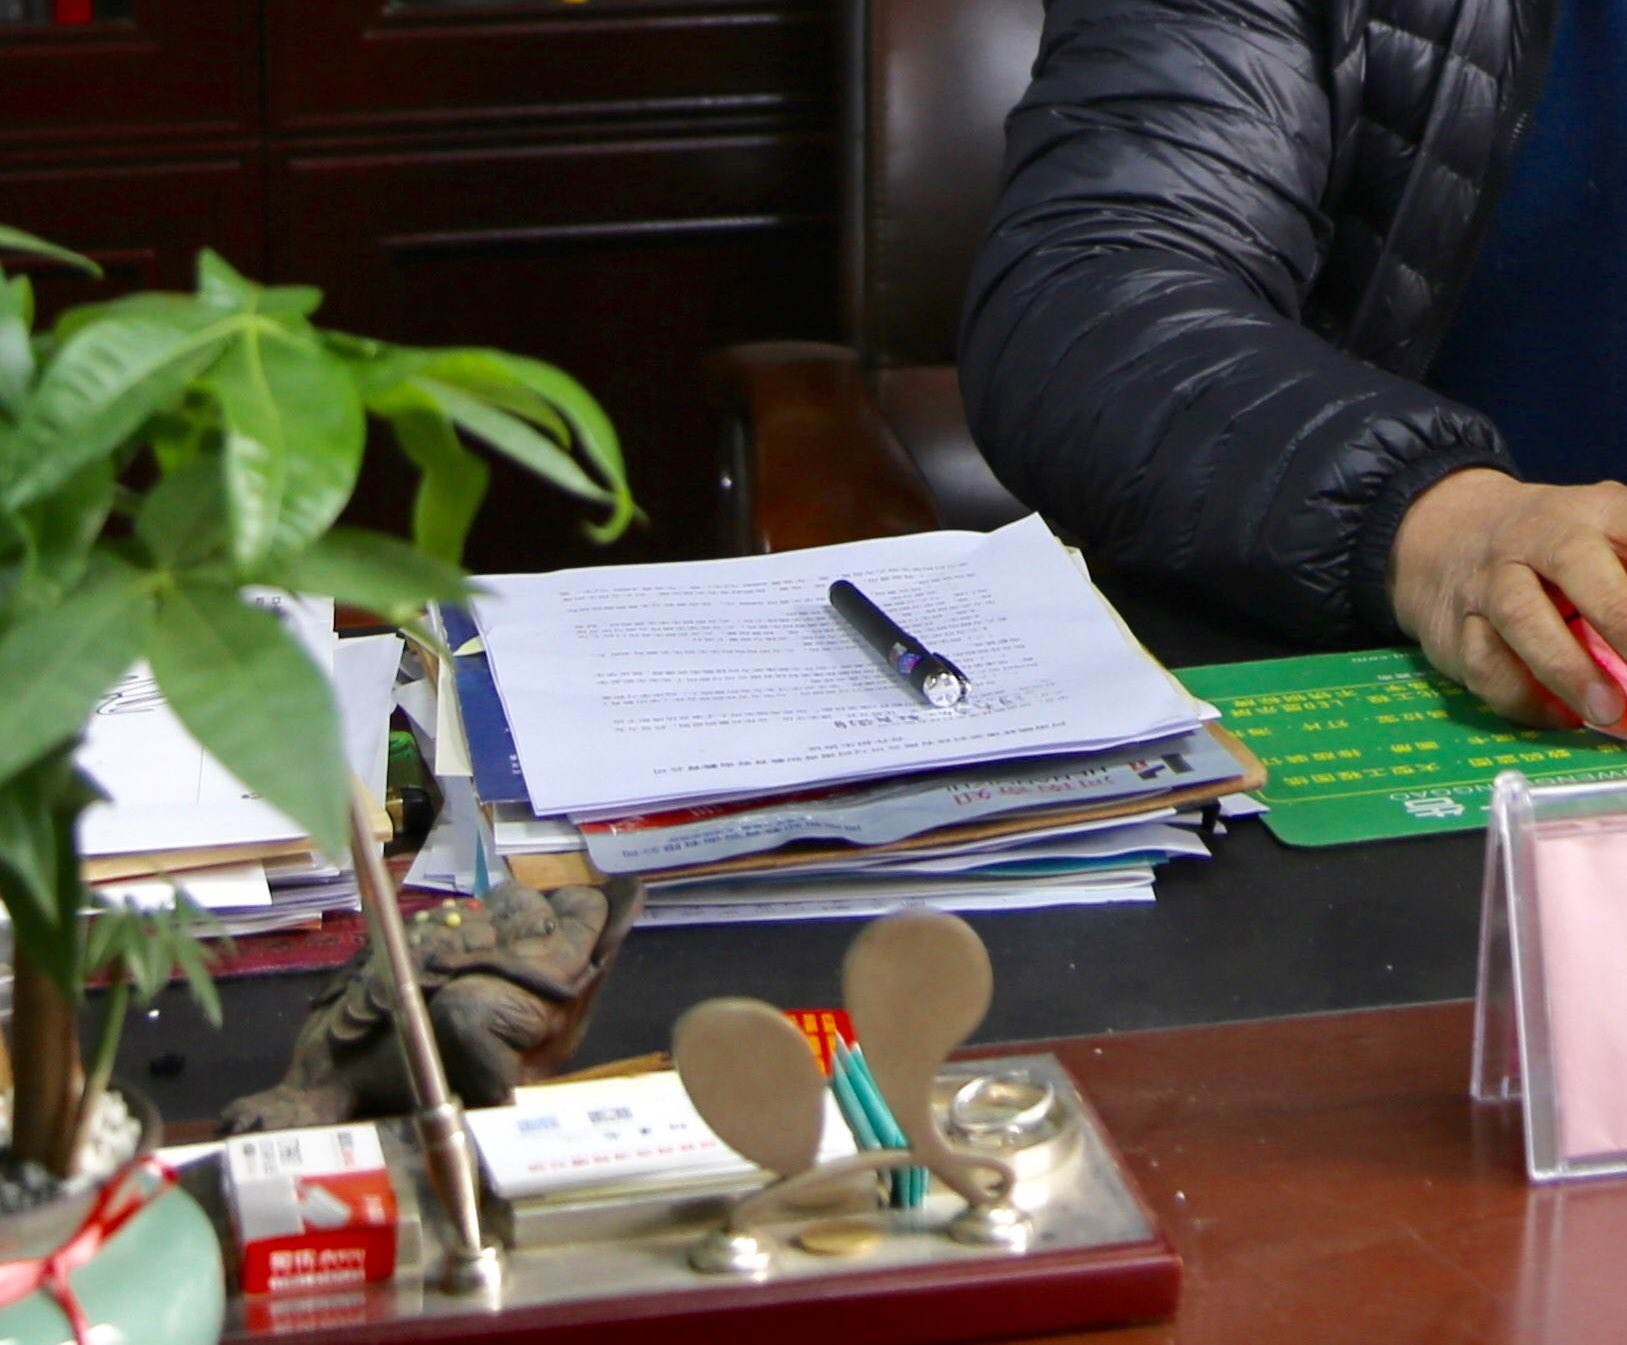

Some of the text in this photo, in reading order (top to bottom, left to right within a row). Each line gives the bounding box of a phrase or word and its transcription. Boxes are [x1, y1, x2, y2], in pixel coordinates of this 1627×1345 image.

[1283, 761, 1440, 787] 大型工程图纸
